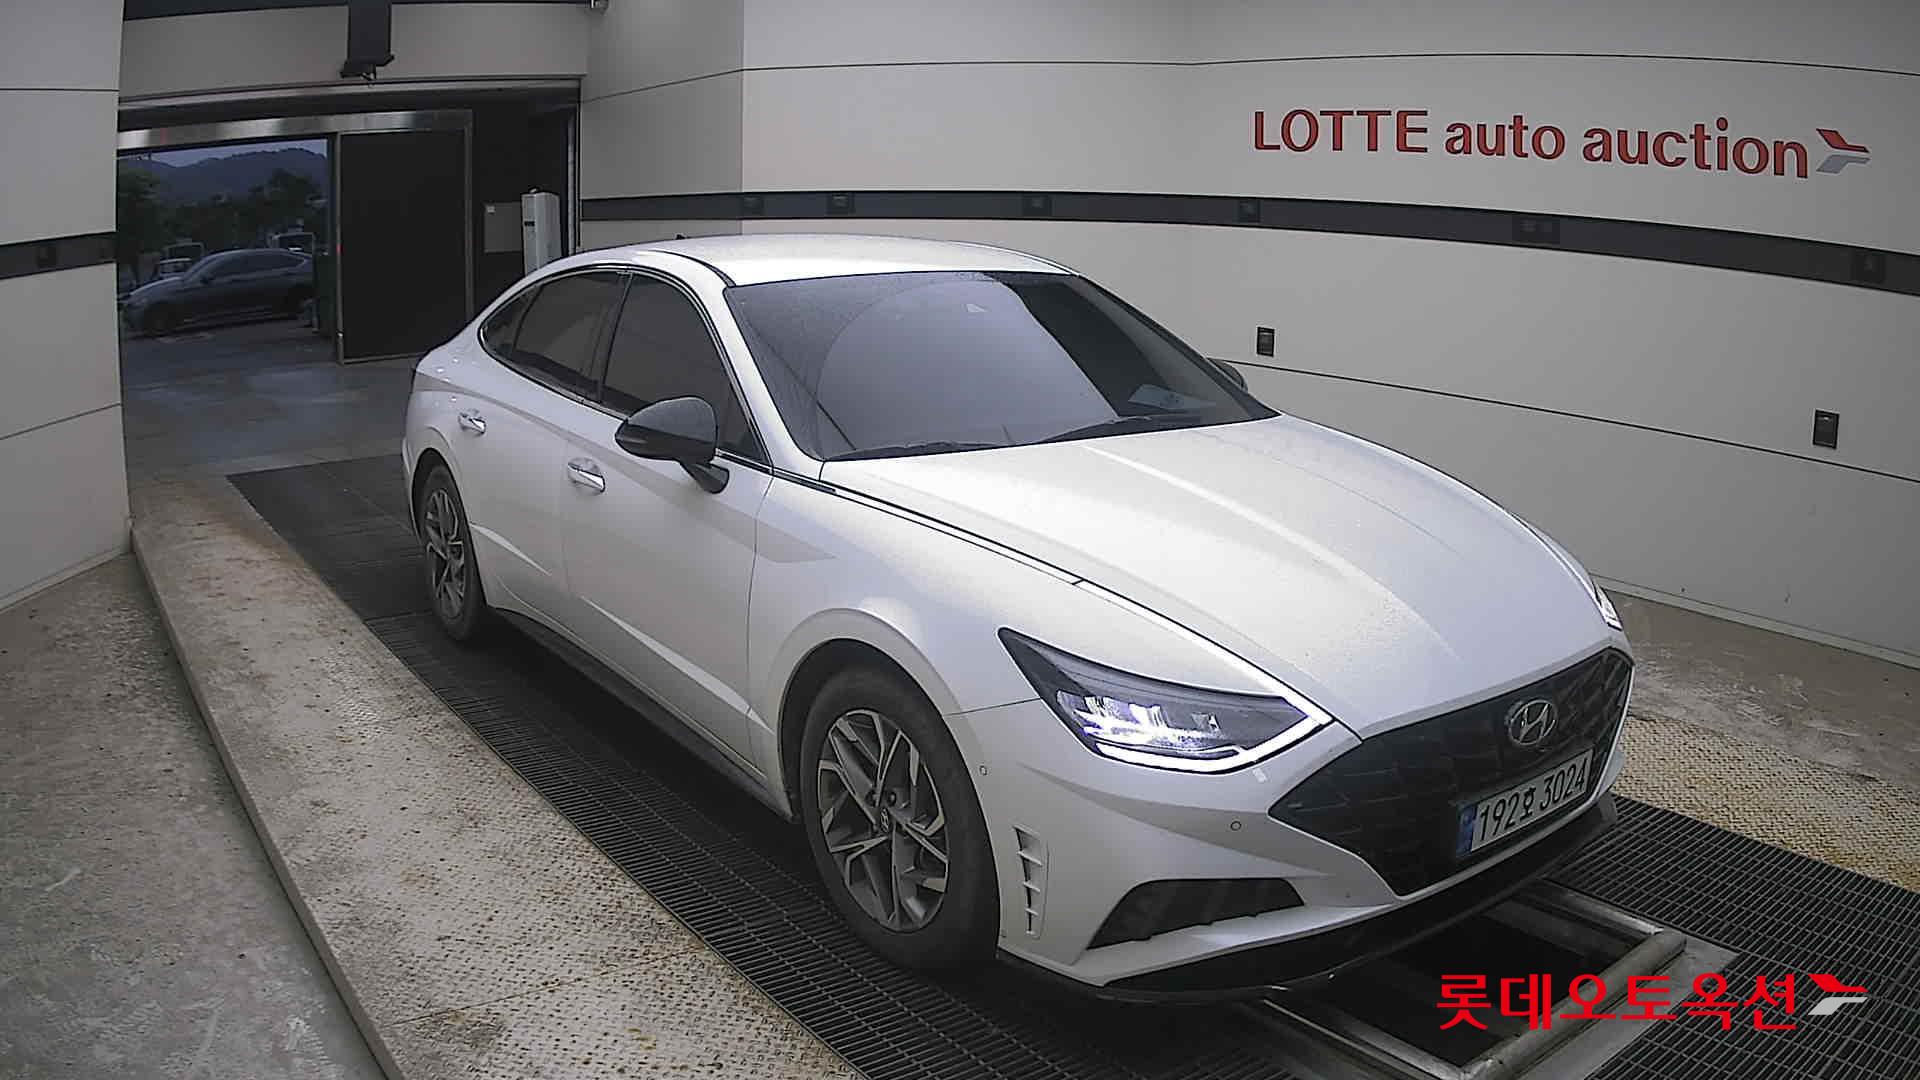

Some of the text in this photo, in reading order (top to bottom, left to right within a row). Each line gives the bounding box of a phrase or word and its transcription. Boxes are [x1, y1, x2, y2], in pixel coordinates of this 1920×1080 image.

[1254, 110, 1809, 179] LOTTE auto auction
[1479, 757, 1588, 841] 192호 3024
